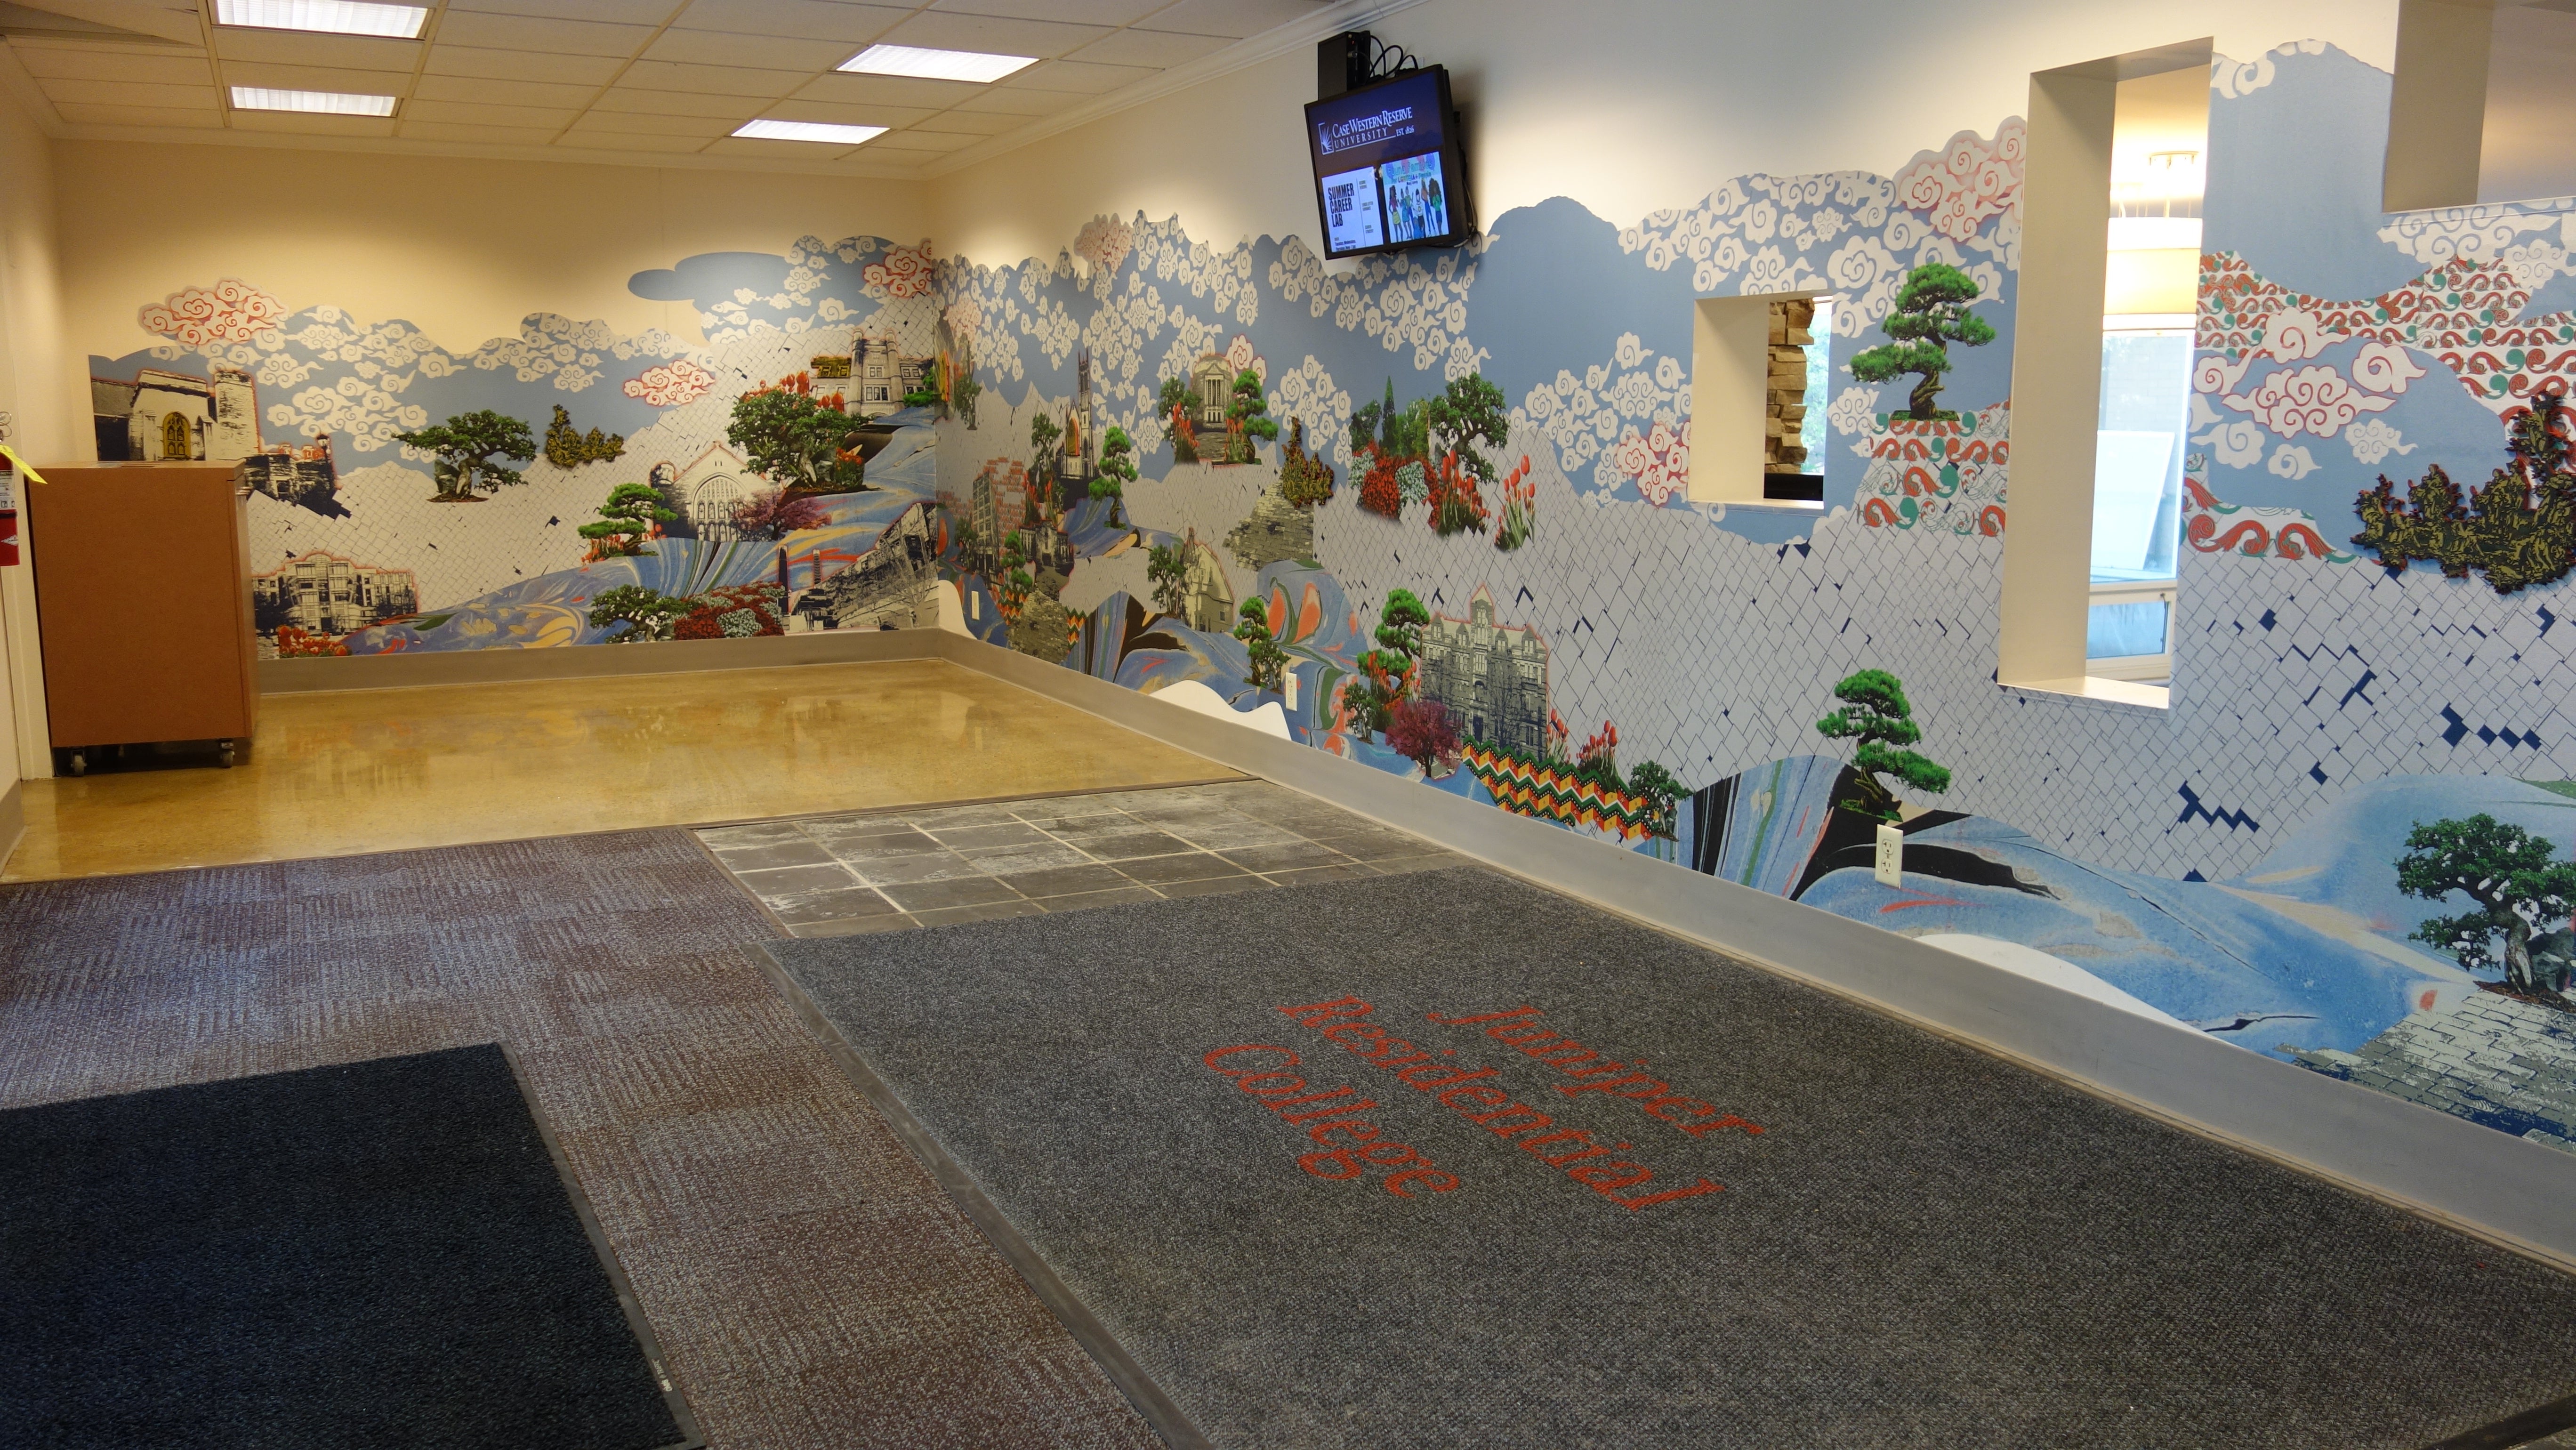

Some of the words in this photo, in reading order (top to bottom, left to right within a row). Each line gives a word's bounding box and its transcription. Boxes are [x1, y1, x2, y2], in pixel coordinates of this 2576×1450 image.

[1332, 124, 1350, 138] CASE
[1349, 115, 1382, 133] WESTERN
[1382, 107, 1413, 127] RESERVE
[1334, 127, 1387, 149] UNIVERSITY
[1405, 125, 1415, 135] 1826
[1328, 183, 1355, 201] SUMMER
[1330, 197, 1353, 214] CAREER
[1332, 213, 1343, 227] LAB
[1427, 1004, 1764, 1138] Juniper
[1277, 994, 1724, 1211] Residential
[1203, 1044, 1460, 1198] College
